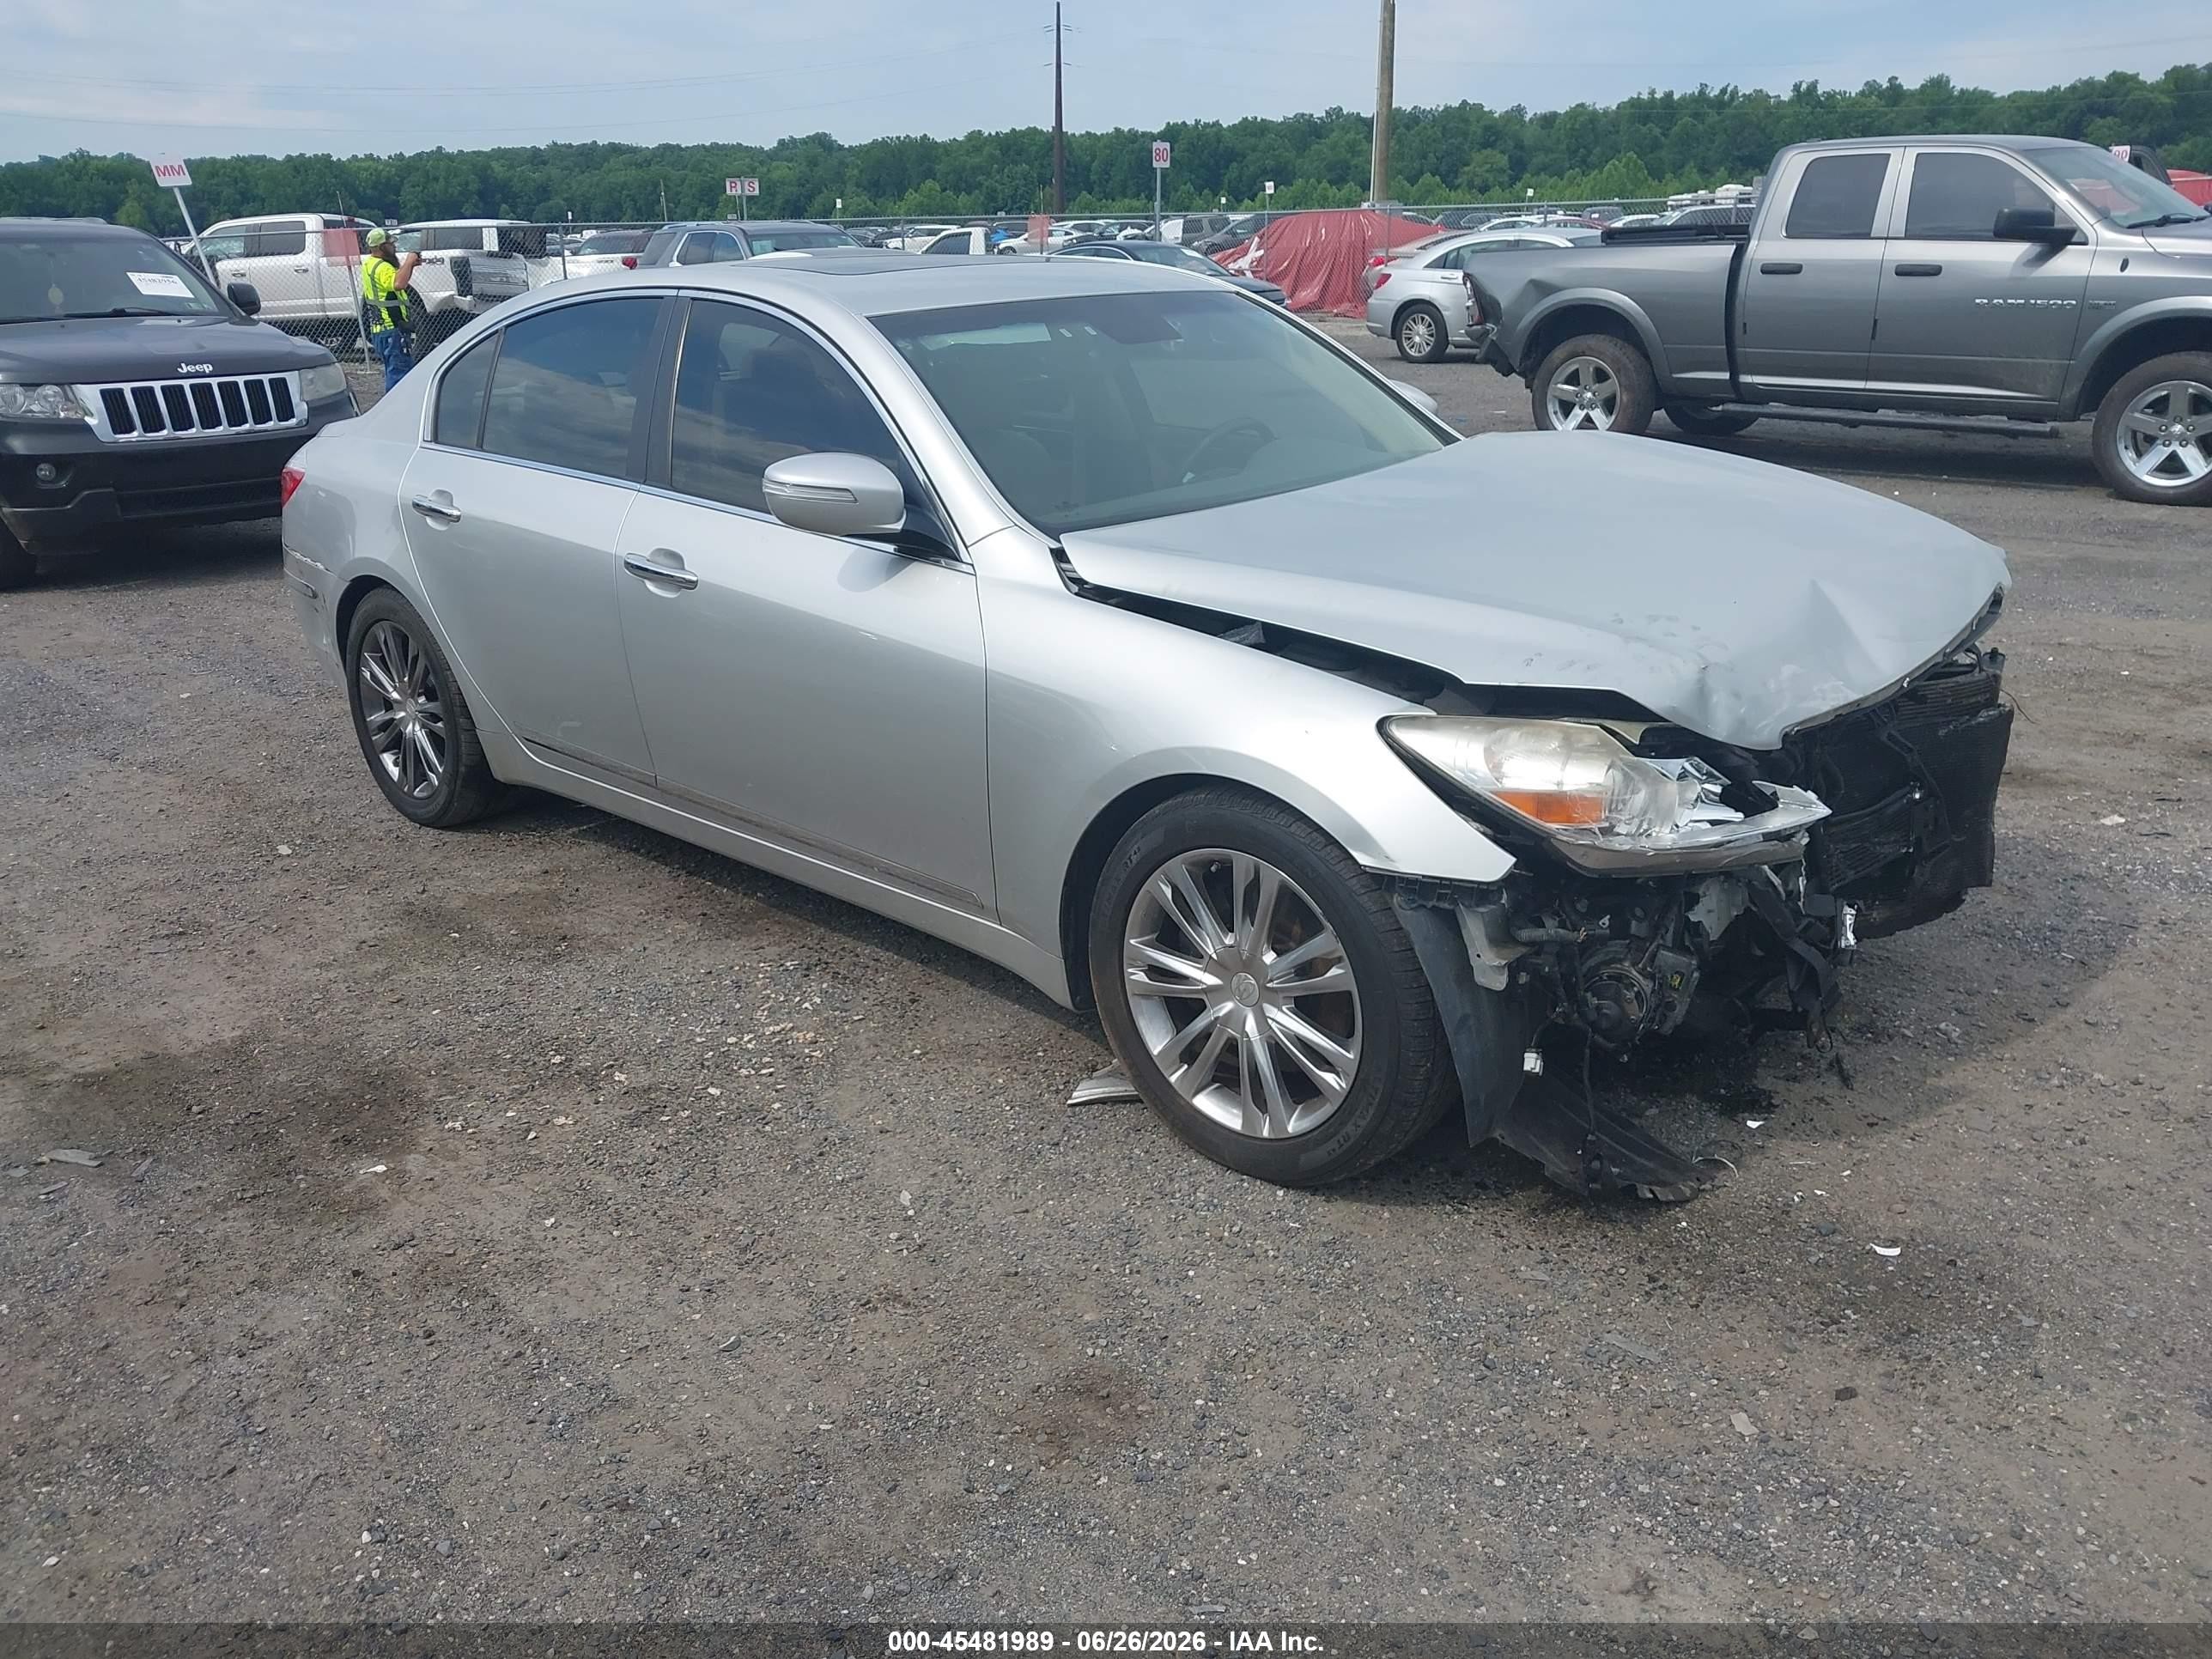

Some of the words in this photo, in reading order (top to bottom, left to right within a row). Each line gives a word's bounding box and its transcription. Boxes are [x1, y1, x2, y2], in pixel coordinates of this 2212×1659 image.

[1154, 147, 1168, 162] 80
[155, 164, 186, 177] MM
[729, 181, 738, 192] R
[747, 181, 756, 192] S
[1975, 298, 2026, 307] RAM
[2030, 299, 2077, 309] 1500
[177, 362, 213, 374] Jeep
